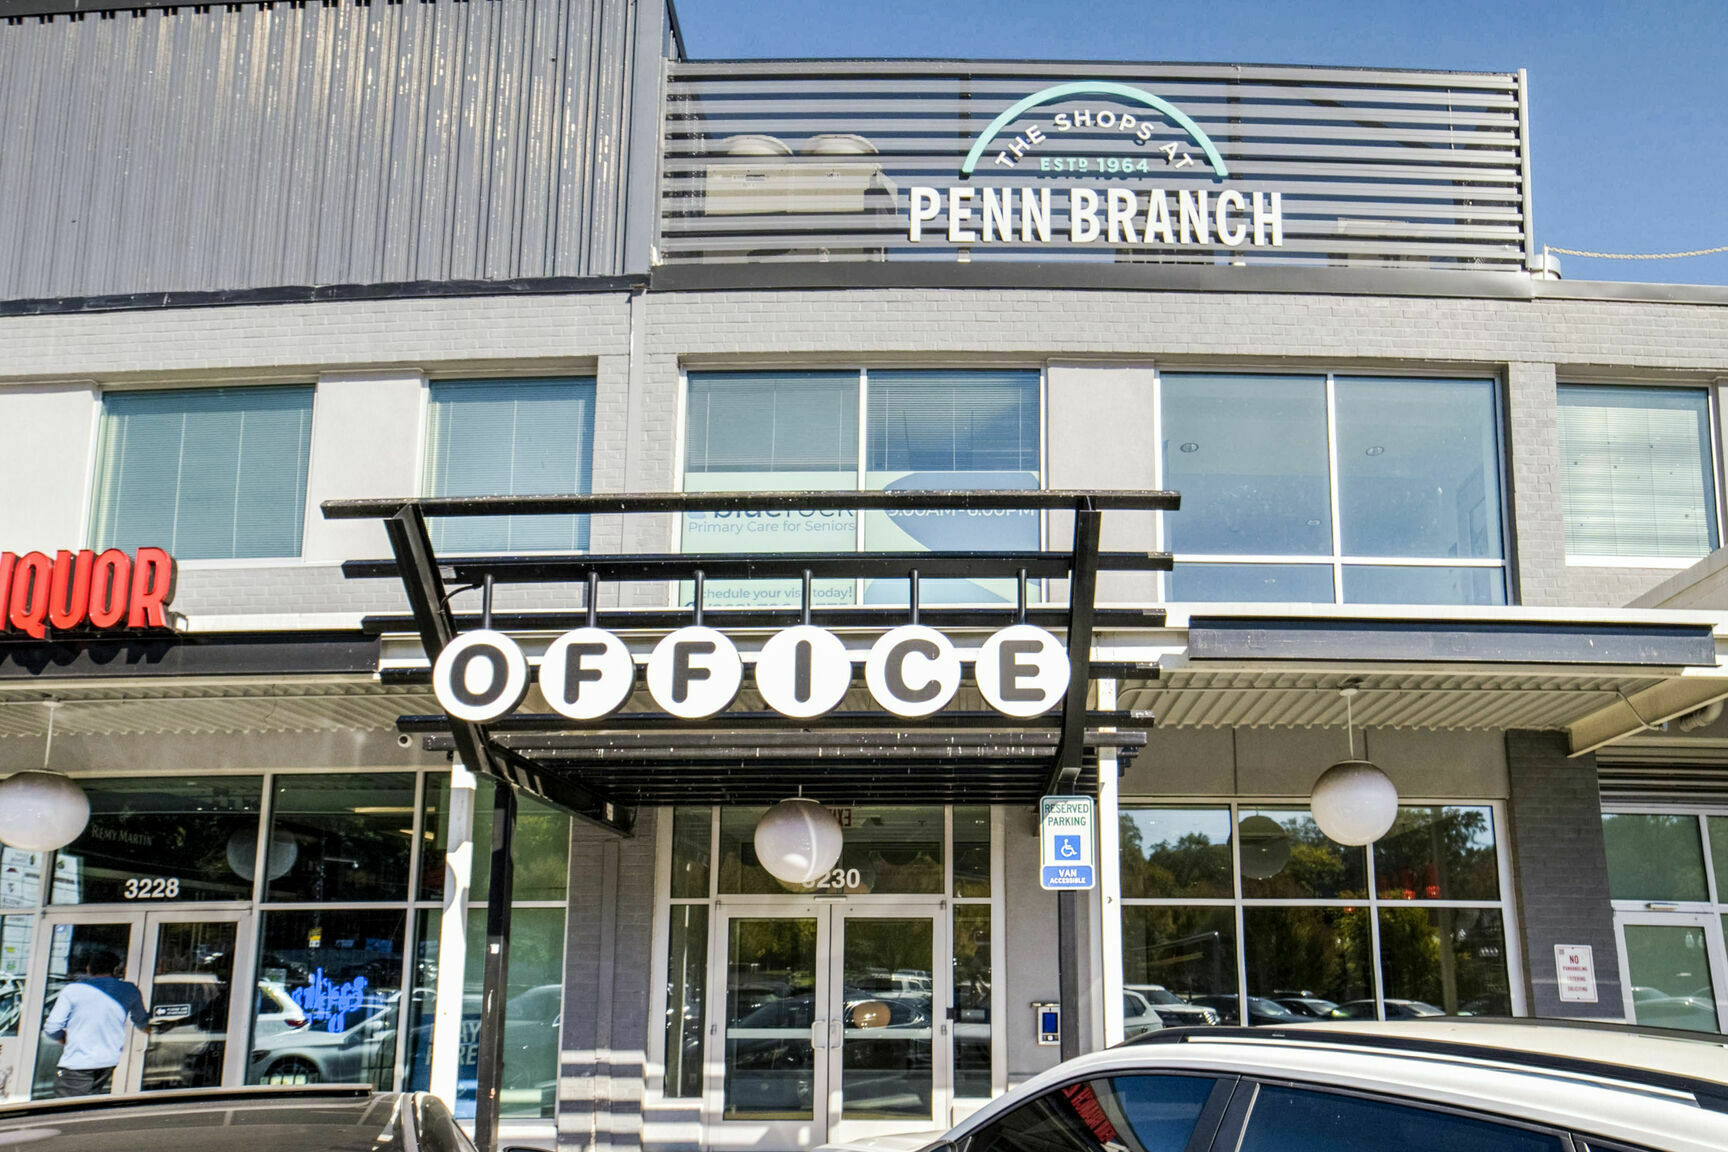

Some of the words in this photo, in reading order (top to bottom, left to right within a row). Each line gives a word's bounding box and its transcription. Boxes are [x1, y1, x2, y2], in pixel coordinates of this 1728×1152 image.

[995, 124, 1046, 168] THE
[1054, 110, 1155, 140] SHOPS
[1159, 141, 1195, 169] AT
[1097, 157, 1150, 173] 1964
[909, 186, 1051, 243] PENN
[1071, 187, 1283, 247] BRANCH
[688, 521, 744, 535] Primary
[746, 520, 779, 532] Care
[783, 520, 800, 531] for
[805, 520, 856, 532] Seniors
[694, 588, 751, 599] hedule
[753, 590, 782, 601] your
[784, 587, 801, 598] vis
[813, 586, 852, 599] today!
[449, 638, 1047, 706] OFFICE
[1044, 803, 1089, 814] RESERVED
[1047, 816, 1087, 826] PARKING
[1058, 869, 1078, 877] VAN
[124, 877, 180, 899] 3228
[1569, 955, 1579, 964] NO
